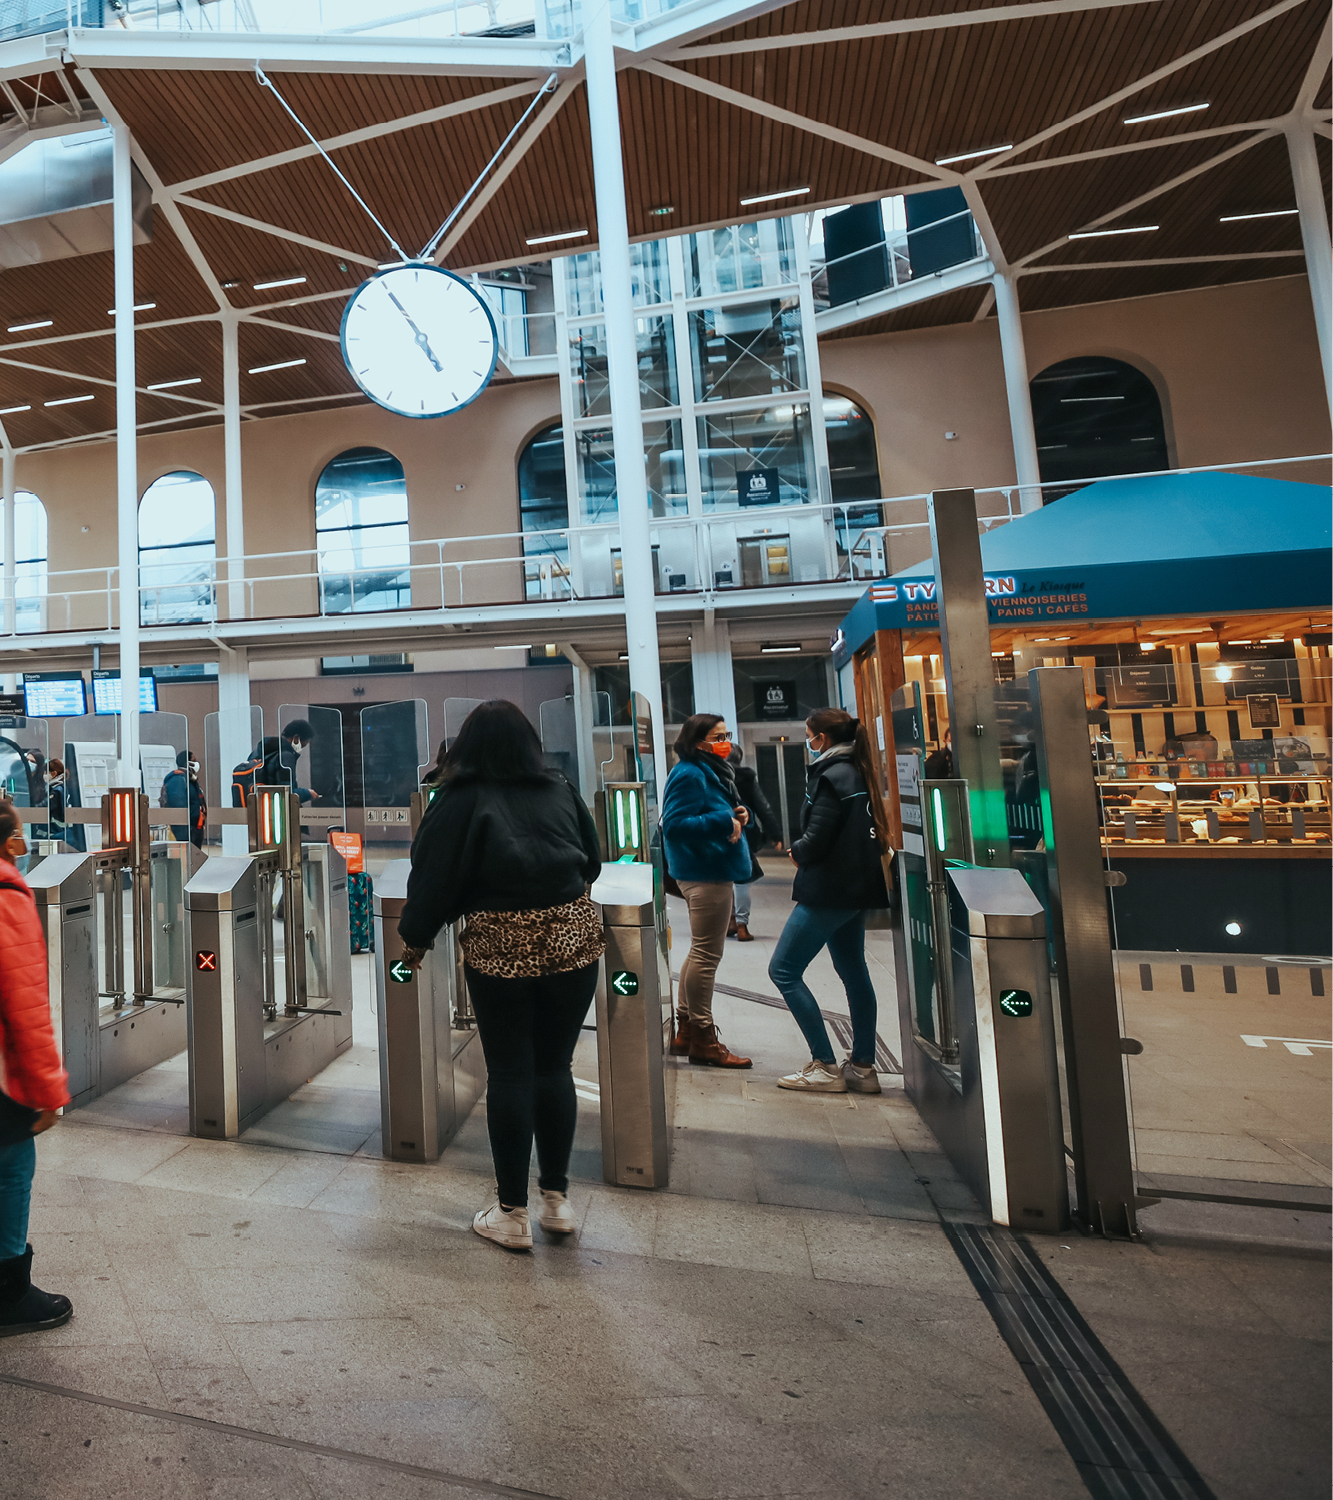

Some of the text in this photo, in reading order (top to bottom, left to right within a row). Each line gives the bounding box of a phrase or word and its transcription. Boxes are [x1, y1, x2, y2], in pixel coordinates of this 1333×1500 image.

[905, 582, 935, 598] TY
[1022, 582, 1035, 593] Le
[1040, 580, 1085, 593] Kiosque
[906, 594, 1087, 612] SAND VIENNOISERIES
[907, 603, 1088, 621] PÂTIS PAINS CAFÉS
